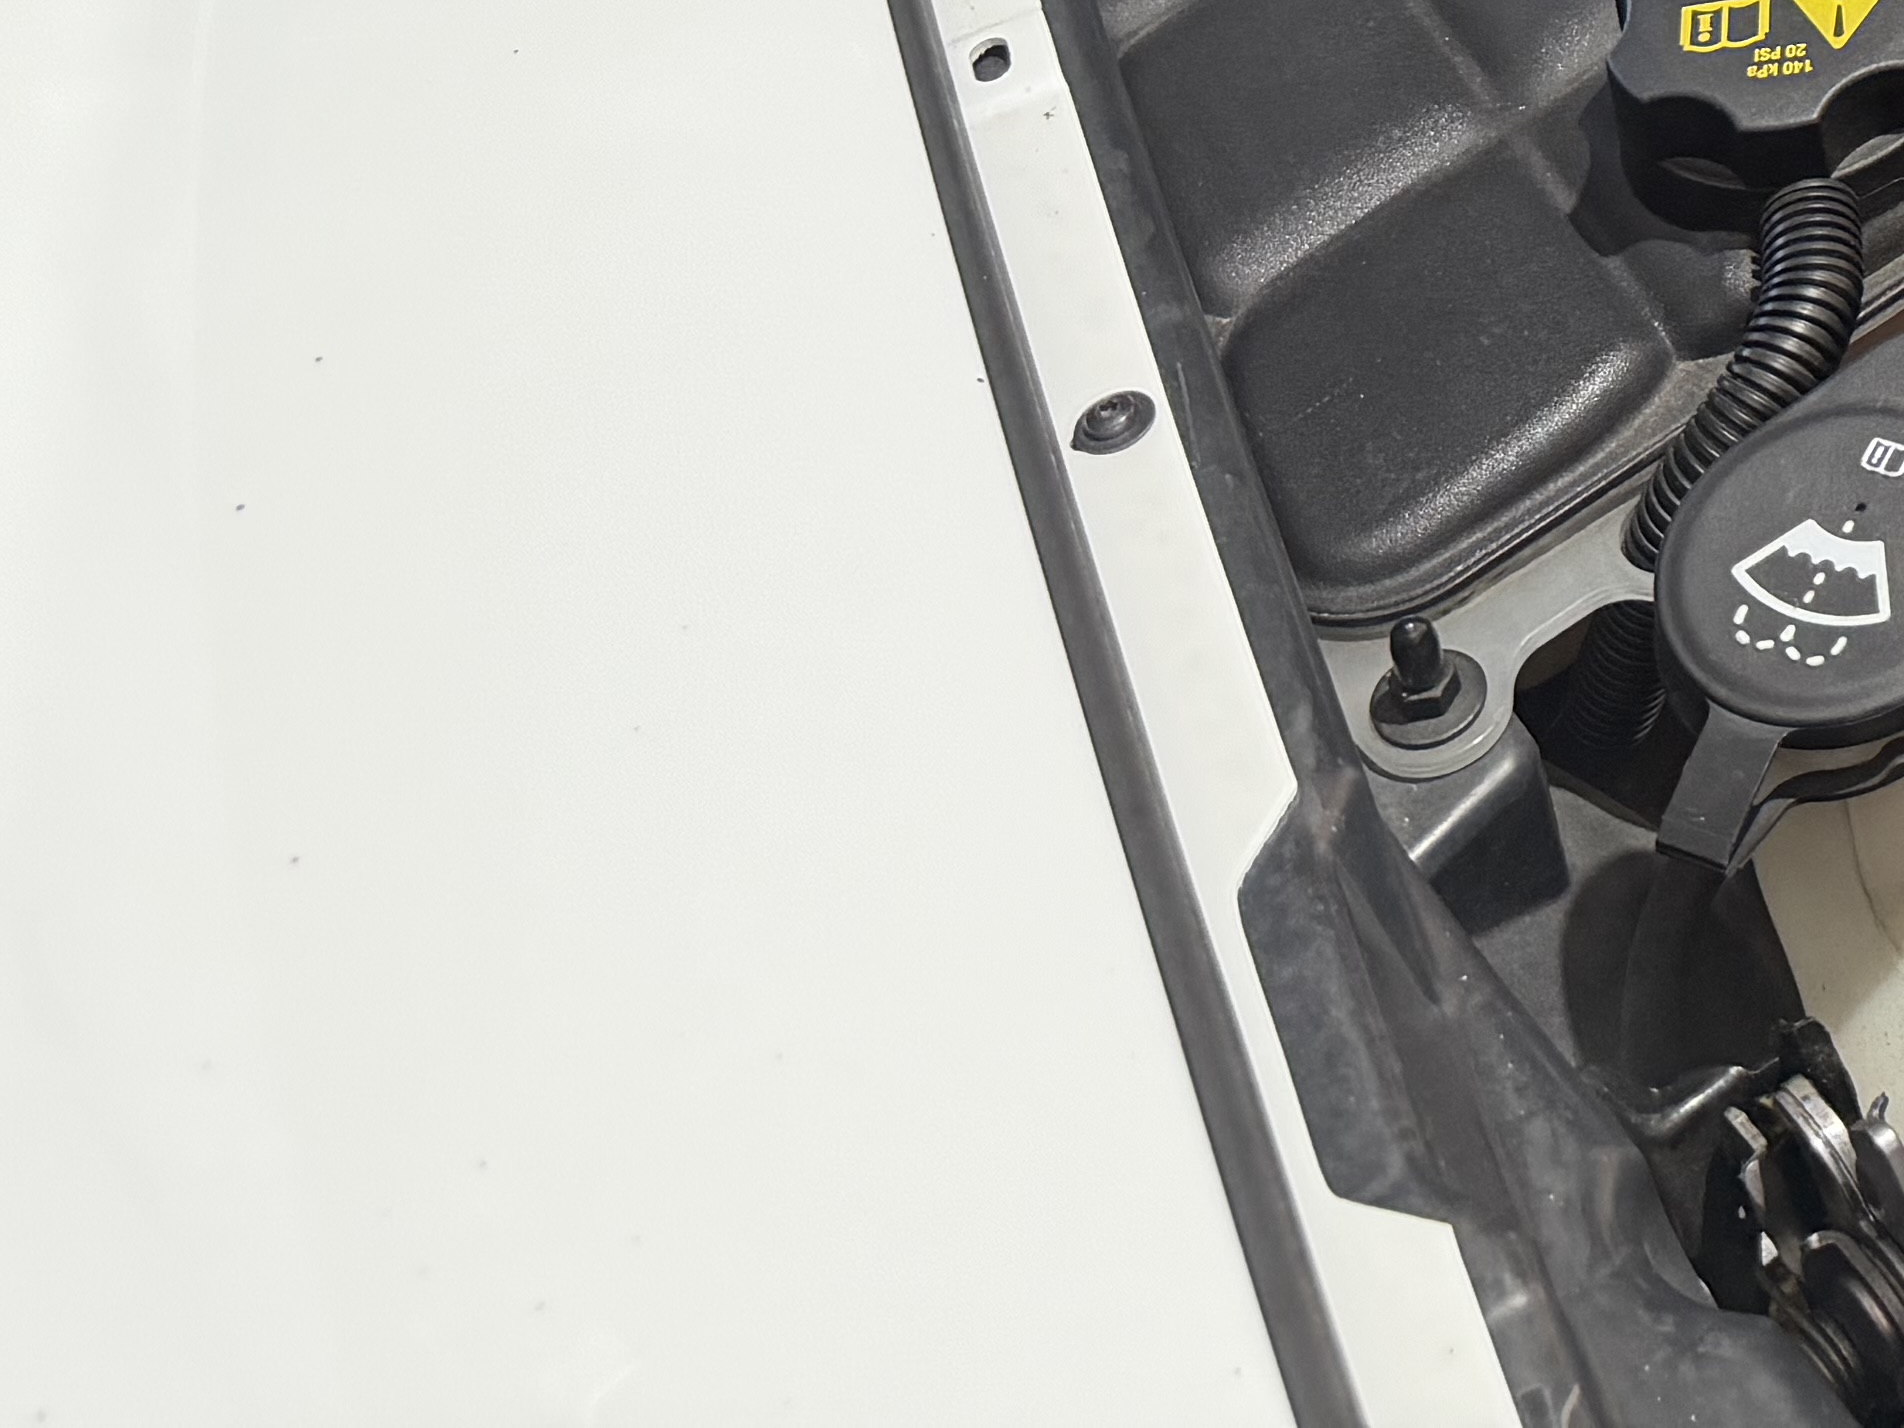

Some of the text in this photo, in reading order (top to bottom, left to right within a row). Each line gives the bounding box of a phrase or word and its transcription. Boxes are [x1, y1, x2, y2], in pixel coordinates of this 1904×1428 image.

[1754, 43, 1807, 61] 20 PSI
[1746, 60, 1813, 79] 140 kPa
